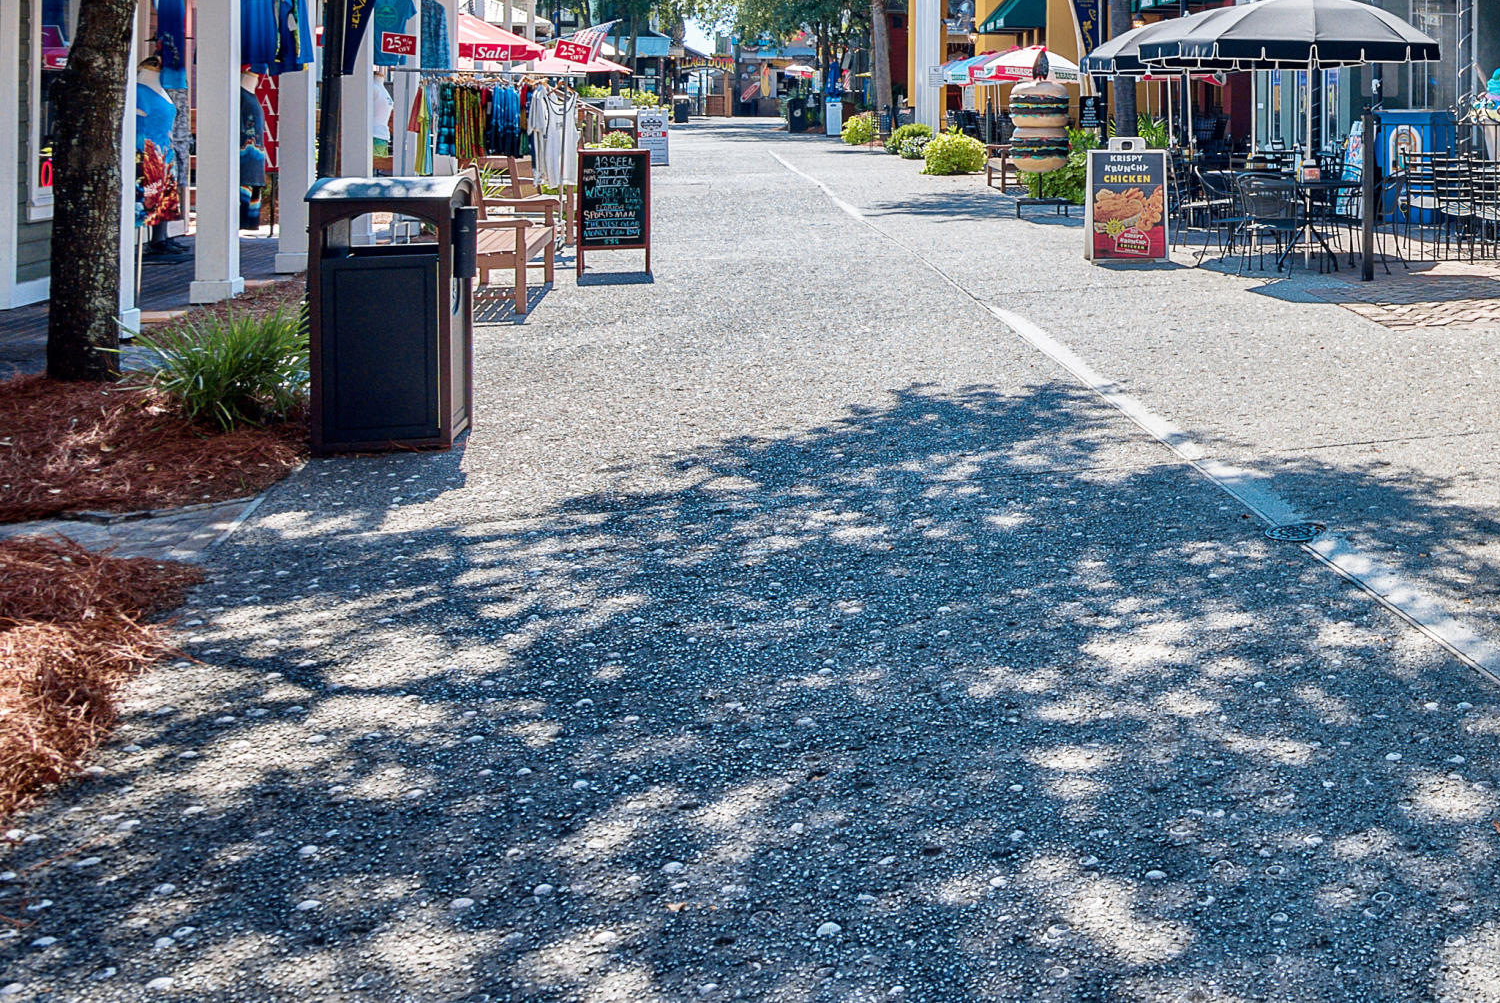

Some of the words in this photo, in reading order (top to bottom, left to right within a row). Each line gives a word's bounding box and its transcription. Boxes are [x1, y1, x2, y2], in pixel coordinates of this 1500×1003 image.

[475, 47, 509, 60] Sale
[708, 57, 735, 74] DOOR
[1005, 67, 1033, 77] TABASC
[1104, 164, 1149, 173] KRUNCHY
[1103, 175, 1151, 183] CHICKEN
